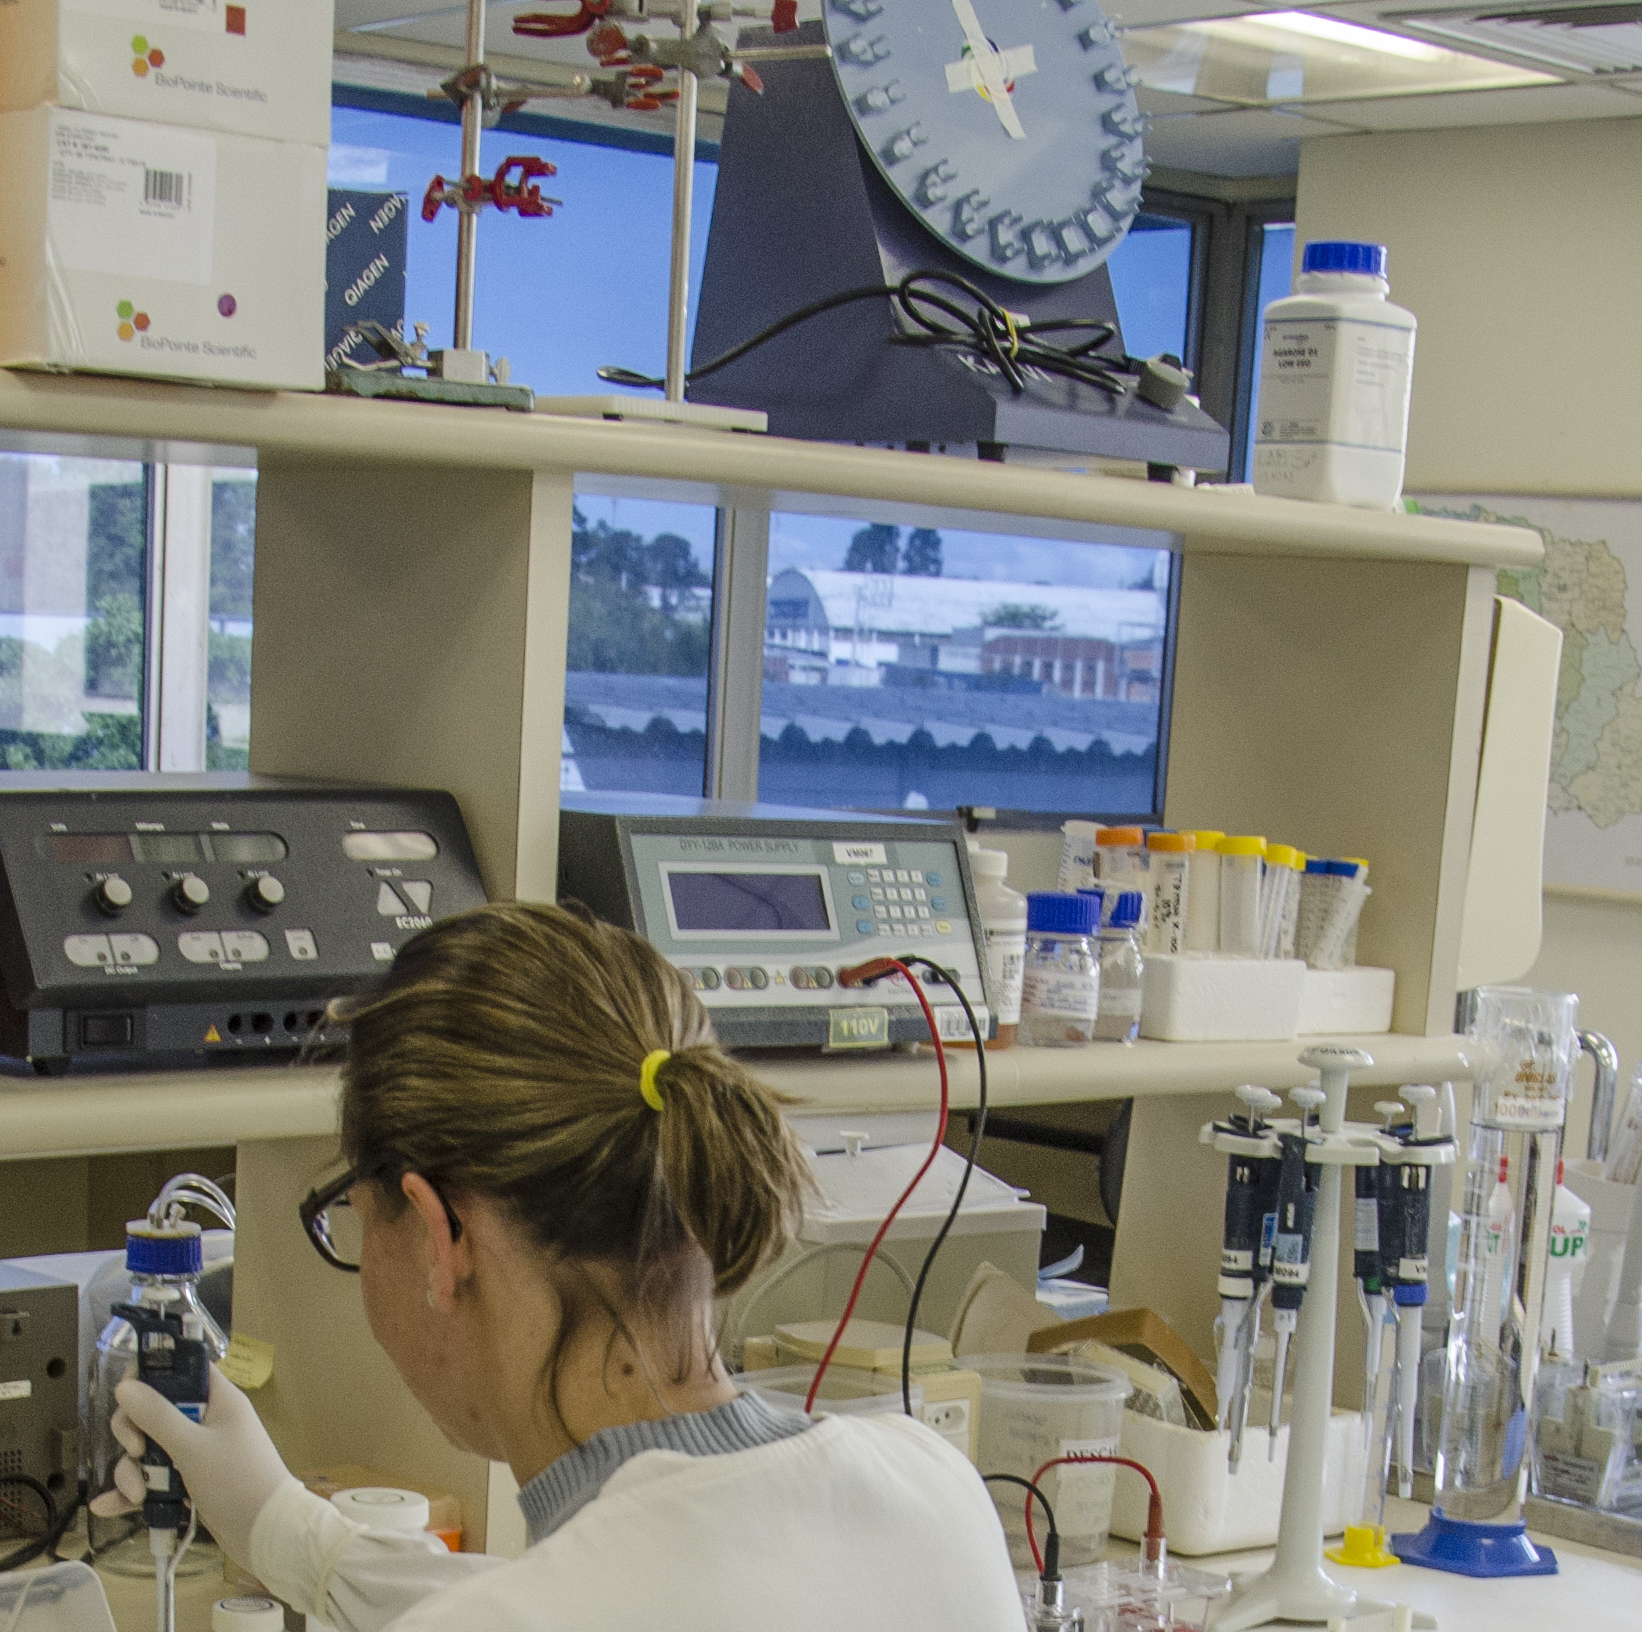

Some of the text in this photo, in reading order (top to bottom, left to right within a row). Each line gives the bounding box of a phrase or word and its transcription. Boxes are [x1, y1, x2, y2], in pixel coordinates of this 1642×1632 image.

[155, 73, 268, 103] BioPointe Scientific
[343, 252, 391, 308] QIAGEN
[140, 334, 256, 360] BioPointe Scientific
[728, 839, 763, 852] POWER
[765, 839, 799, 853] SUPPLY
[840, 1018, 880, 1037] 110V
